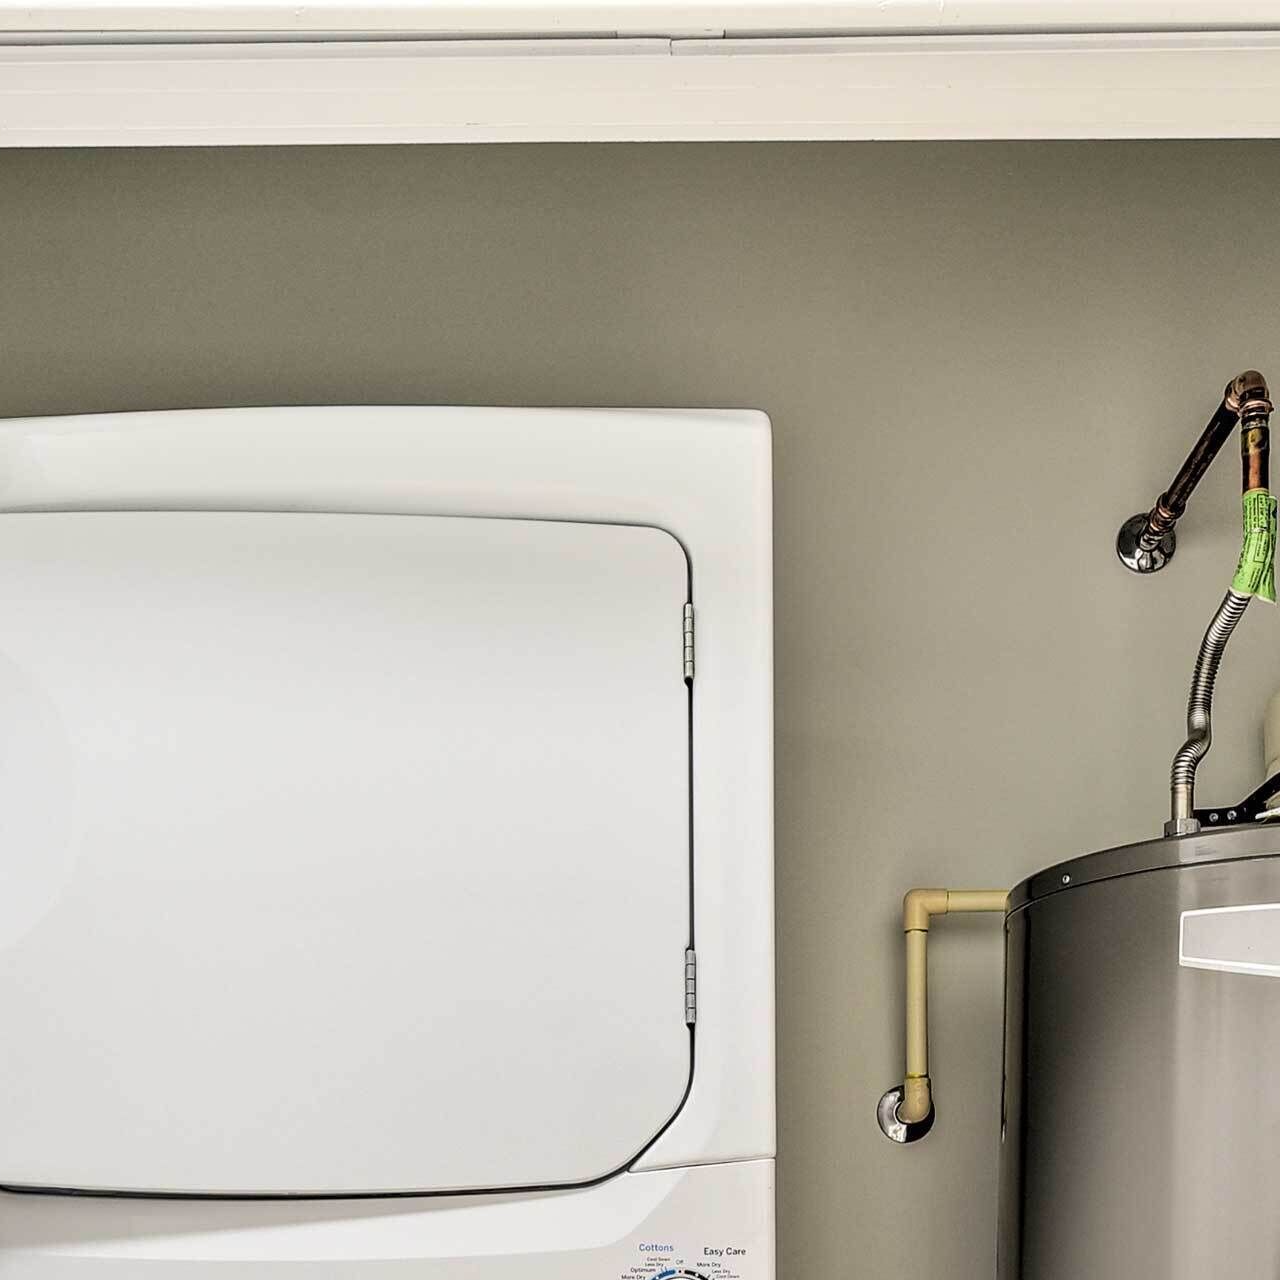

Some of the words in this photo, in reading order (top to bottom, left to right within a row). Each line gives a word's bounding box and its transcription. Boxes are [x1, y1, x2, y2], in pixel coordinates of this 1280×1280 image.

[639, 1244, 674, 1252] Cottons
[704, 1247, 724, 1256] Easy
[726, 1247, 746, 1256] Care
